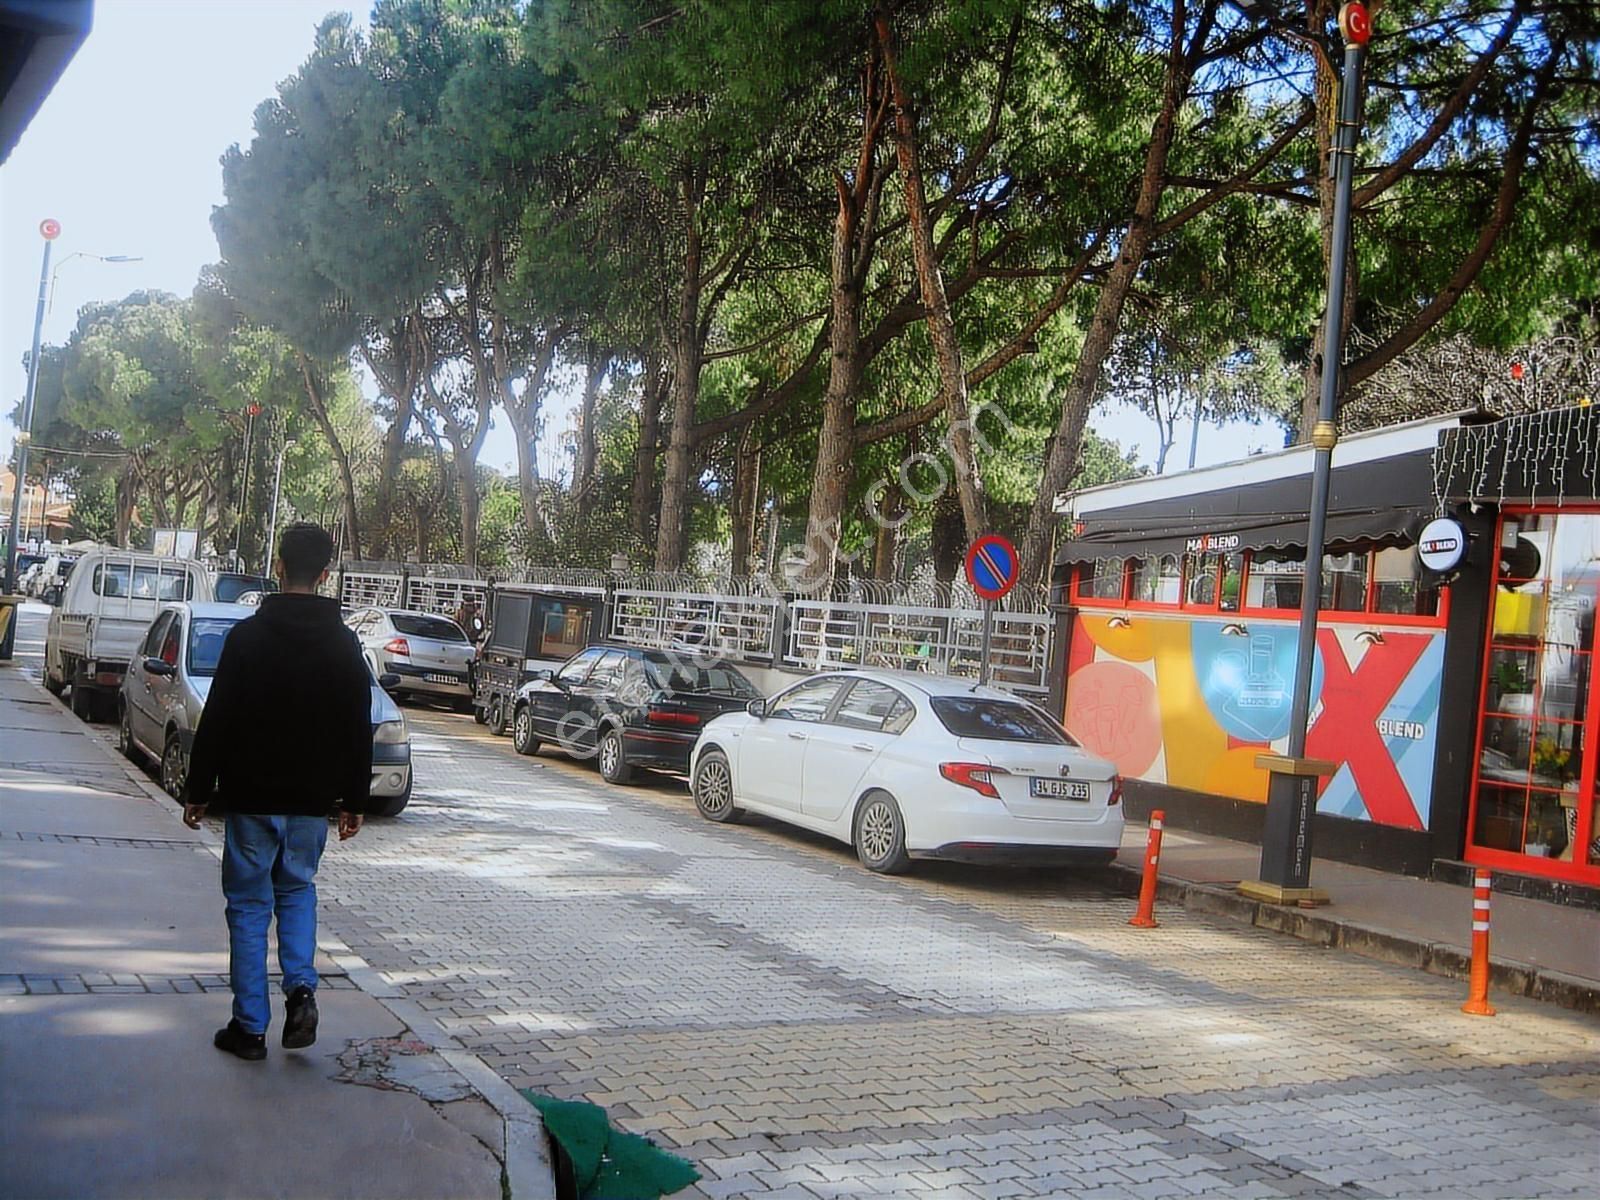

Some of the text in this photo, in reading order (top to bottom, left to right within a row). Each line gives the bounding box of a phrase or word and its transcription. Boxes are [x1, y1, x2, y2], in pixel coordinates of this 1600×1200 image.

[1379, 719, 1425, 740] BLEND
[1037, 781, 1047, 793] 34
[1072, 784, 1087, 797] 235
